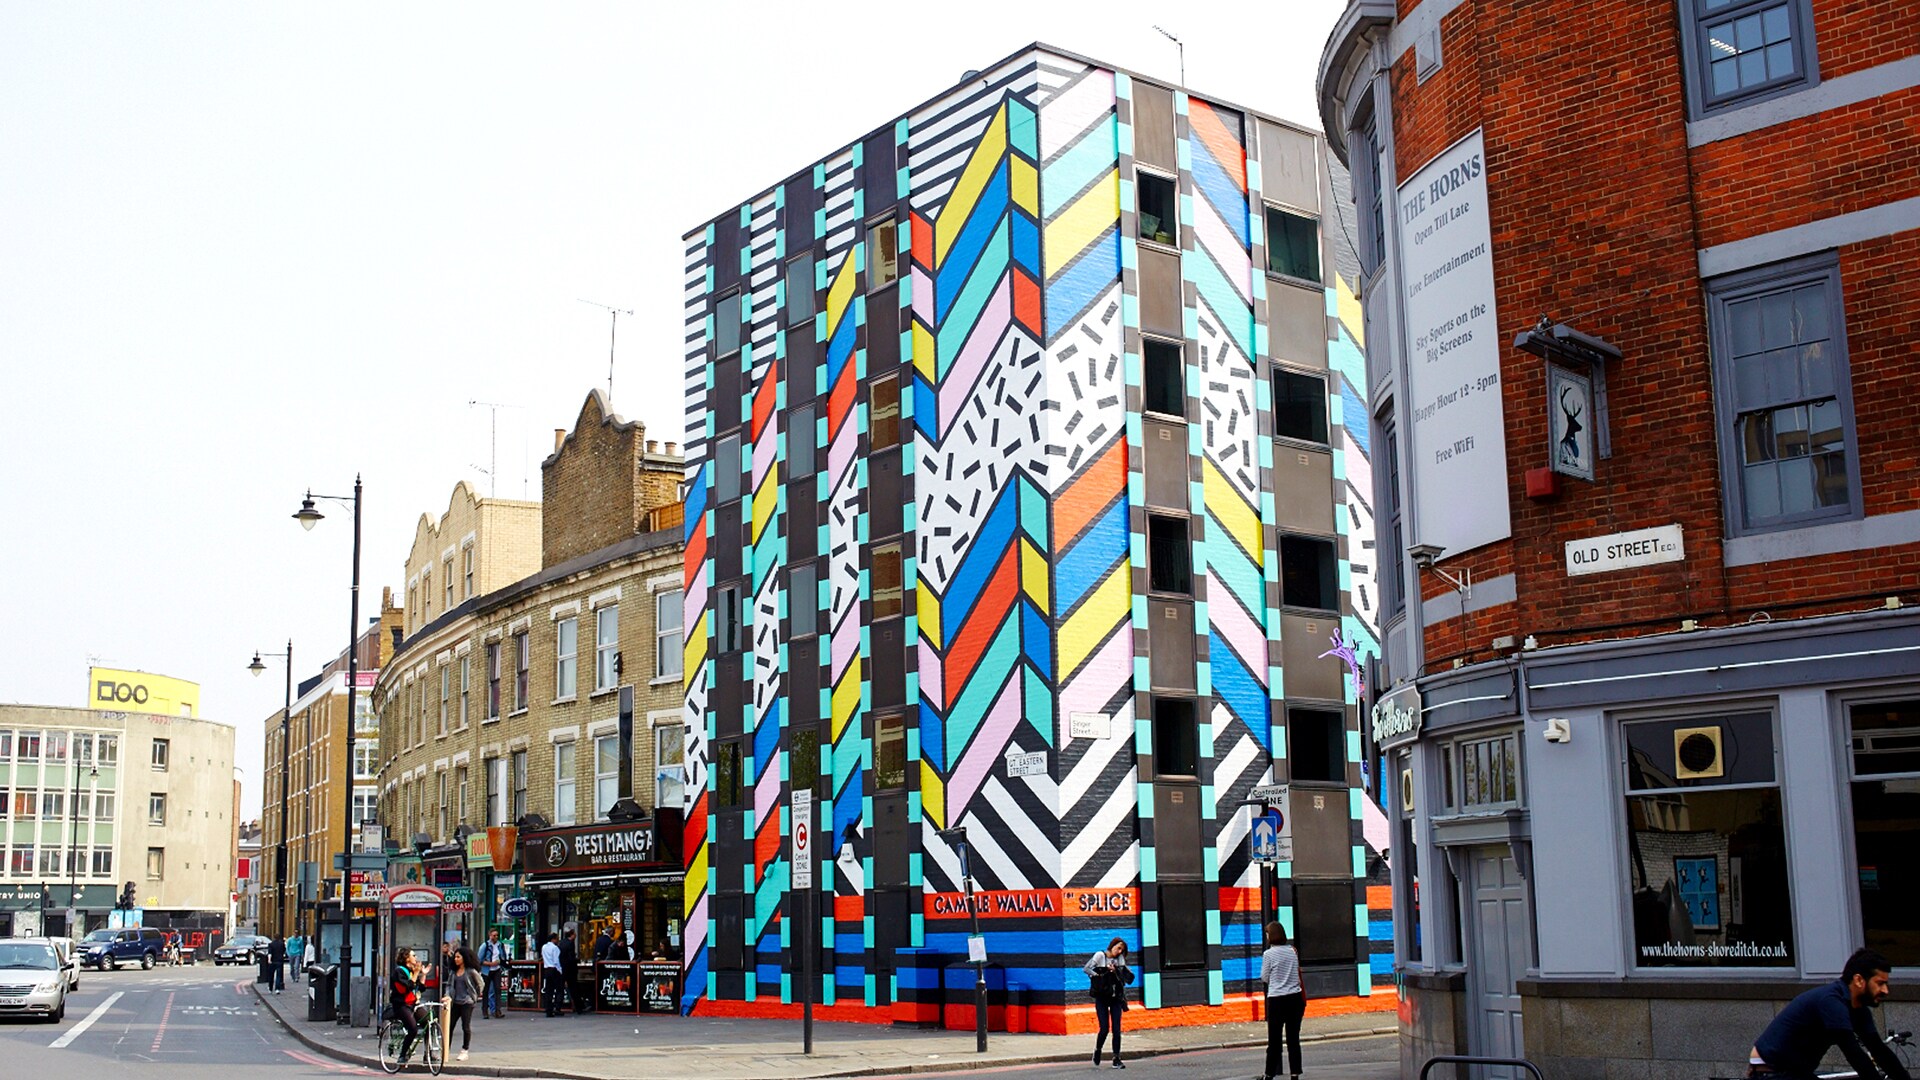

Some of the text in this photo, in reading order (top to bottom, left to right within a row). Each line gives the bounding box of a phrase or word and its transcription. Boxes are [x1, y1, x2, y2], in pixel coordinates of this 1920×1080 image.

[1403, 154, 1481, 225] THE HORNS
[1414, 202, 1470, 245] Open Till Late
[1409, 242, 1486, 298] Live Entertainment
[1416, 303, 1486, 351] Sky Sports on the
[1426, 330, 1473, 363] Big Screens
[1414, 403, 1436, 423] Happy
[1437, 388, 1458, 411] Hour
[1460, 383, 1470, 398] 12
[1477, 373, 1498, 392] 5pm
[1435, 436, 1475, 465] Free WiFi
[1573, 548, 1599, 564] OLD
[1607, 538, 1660, 559] STREET
[1072, 720, 1091, 728] Singer
[1009, 766, 1029, 776] STREET
[1019, 756, 1044, 767] EASTERN
[1253, 787, 1287, 797] Controlled
[472, 838, 486, 857] FOOD
[574, 833, 604, 856] BEST
[591, 852, 647, 864] BAR & RESTAURANT
[445, 895, 468, 903] OPEN
[454, 902, 473, 910] CASH
[507, 903, 529, 912] cash
[934, 895, 991, 914] CAMLE
[996, 893, 1055, 912] WALALA
[1078, 892, 1132, 912] SPLICE
[1641, 940, 1788, 958] www.thehorns-shoreditch.co.uk
